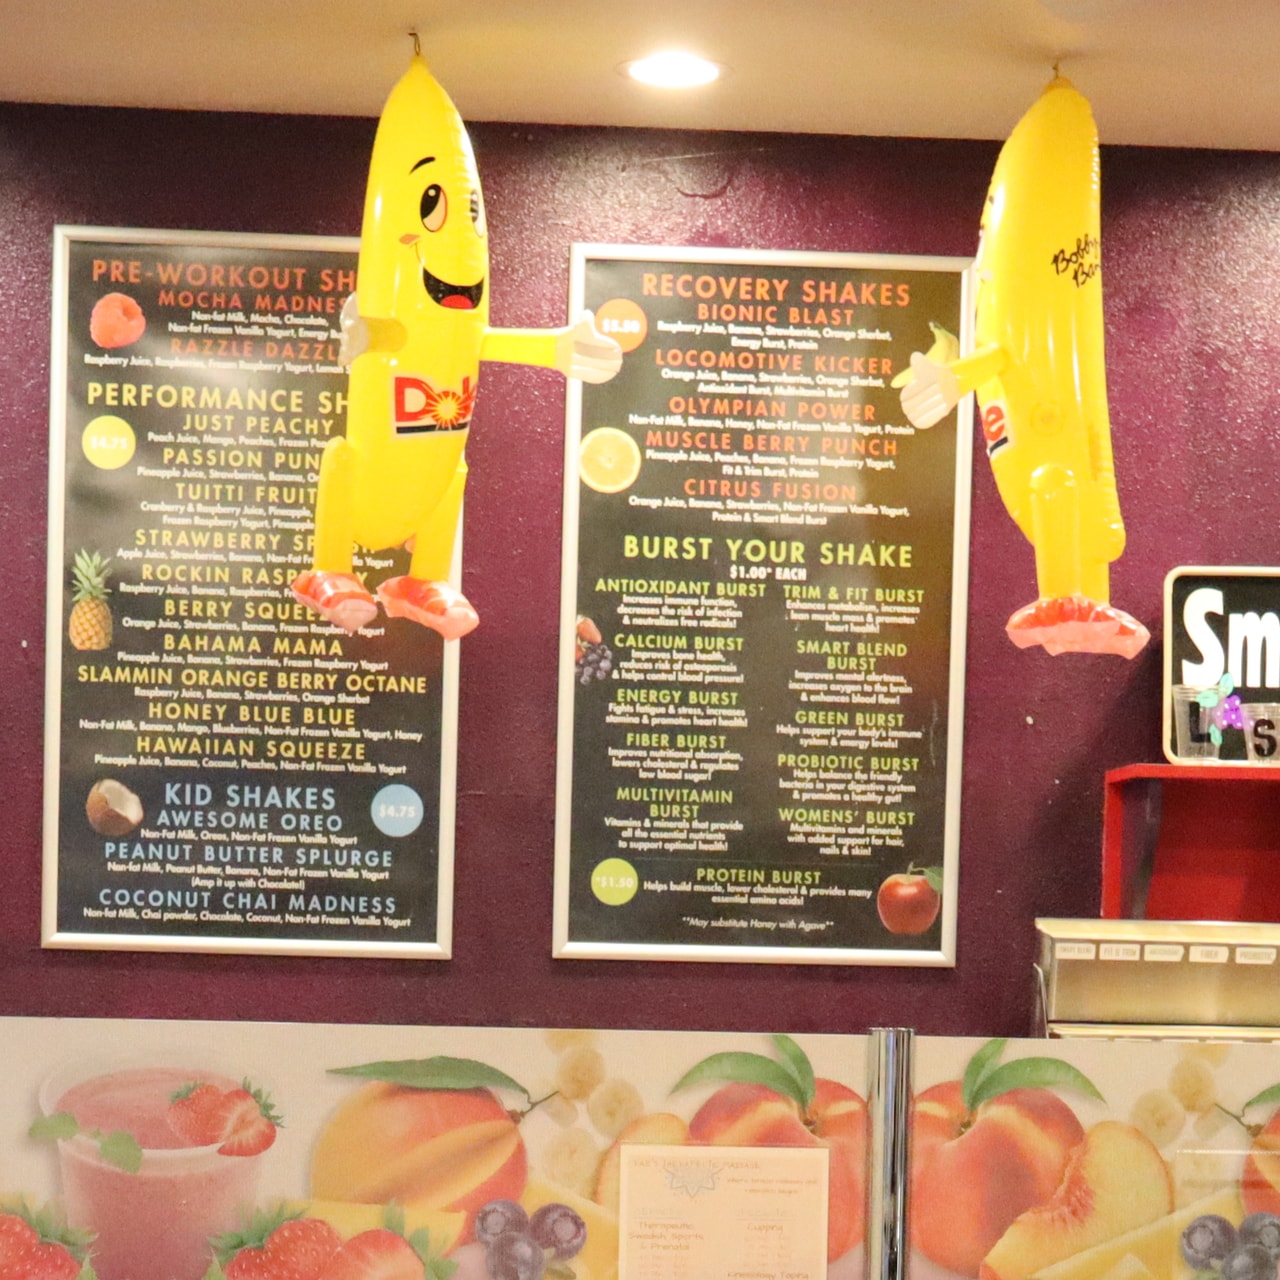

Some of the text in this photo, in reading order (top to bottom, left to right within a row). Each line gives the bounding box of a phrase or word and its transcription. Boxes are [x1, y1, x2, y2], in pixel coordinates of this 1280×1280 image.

[93, 260, 307, 290] PRE-WORKOUT
[1072, 262, 1101, 288] Ban
[642, 273, 910, 307] RECOVERY SHAKES
[158, 291, 347, 314] MOCHA MADNE
[697, 304, 853, 326] BIONIC BLAST
[171, 339, 337, 361] RAZZLE DAZZL
[655, 349, 893, 375] LOCOMOTIVE KICKER
[88, 383, 303, 412] PERFORMANCE
[395, 376, 477, 427] Dol
[669, 396, 875, 421] OLYMPIAN POWER
[183, 415, 333, 435] JUST PEACHY
[646, 431, 898, 456] MUSCLE BERRY PUNCH
[163, 448, 319, 470] PASSION PUN
[176, 483, 317, 504] TUITTI FRUIT
[684, 478, 856, 501] CITRUS FUSION
[135, 529, 280, 550] STRAWBERRY
[623, 535, 912, 568] BURST YOUR SHAKE
[142, 565, 368, 585] ROCKIN RASPY
[776, 567, 807, 581] EACH
[595, 579, 766, 597] ANTIOXIDANT BURST
[784, 585, 924, 603] TRIM & FIT BURST
[165, 600, 329, 621] BERRY SQUEE
[164, 634, 343, 656] BAHAMA MAMA
[614, 633, 743, 651] CALCIUM BURST
[797, 639, 907, 657] SMART BLEND
[827, 656, 877, 670] BURST
[78, 665, 426, 693] SLAMMIN ORANGE BERRY OCTANE
[617, 688, 738, 705] ENERGY BURST
[148, 702, 355, 726] HONEY BLUE BLUE
[795, 710, 904, 727] GREEN BURST
[137, 737, 365, 760] HAWAIIAN SQUEEZE
[626, 732, 726, 749] FIBER BURST
[1253, 718, 1277, 757] S
[778, 753, 919, 771] PROBIOTIC BURST
[166, 783, 336, 811] KID SHAKES
[617, 787, 733, 804] MULTIVITAMIN
[157, 811, 342, 832] AWESOME OREO
[378, 805, 415, 818] $4.75
[650, 804, 699, 818] BURST
[866, 810, 915, 825] BURST
[105, 842, 393, 868] PEANUT BUTTER SPLURGE
[696, 868, 821, 885] PROTEIN BURST
[100, 889, 396, 914] COCONUT CHAI MADNESS
